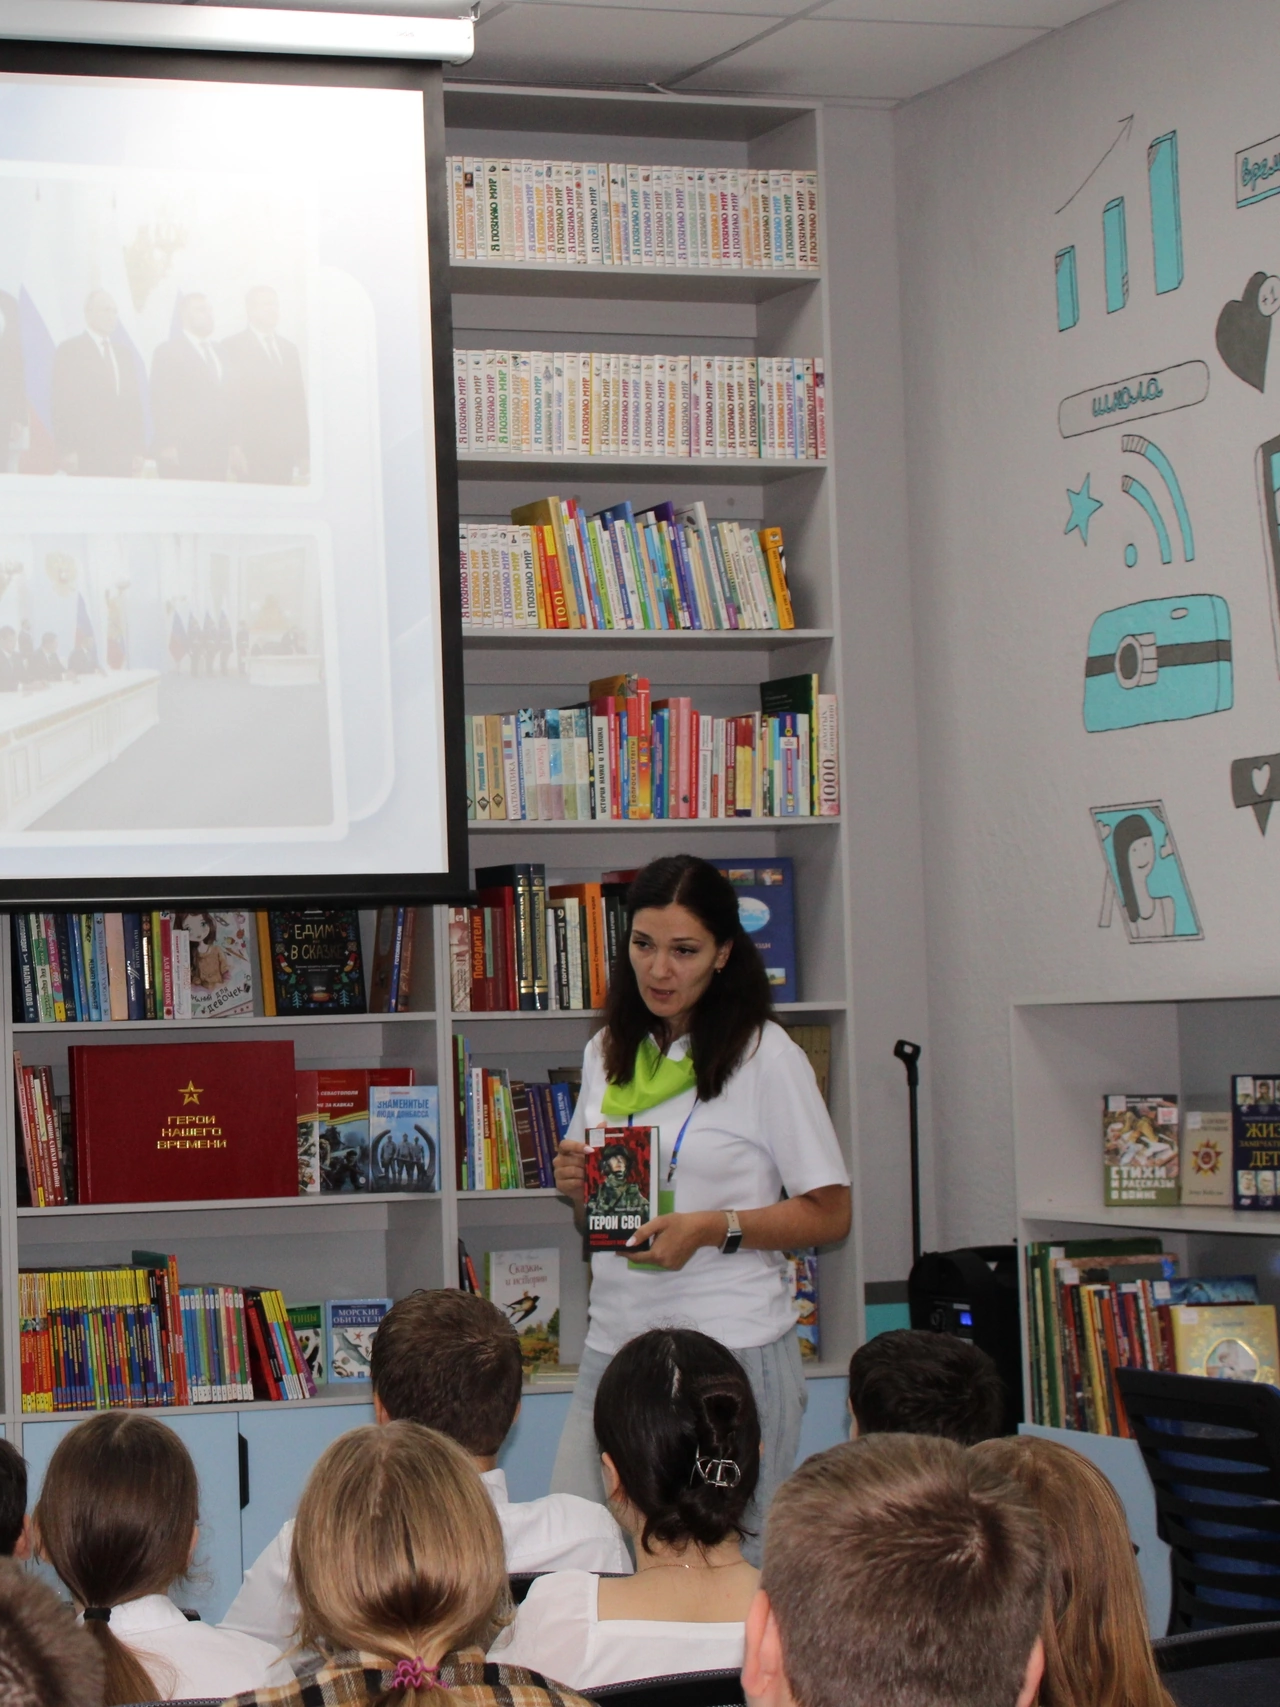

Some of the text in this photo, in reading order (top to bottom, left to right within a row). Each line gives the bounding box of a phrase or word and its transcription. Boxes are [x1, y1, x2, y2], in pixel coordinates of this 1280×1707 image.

[589, 186, 597, 206] МИР
[488, 178, 500, 252] Я ПОЗНАЮ МИР
[590, 207, 599, 245] ПОЗНАЮ
[458, 376, 466, 396] МИР
[498, 370, 508, 444] Я ПОЗНАЮ МИР
[1092, 377, 1163, 417] школа
[458, 397, 467, 435] ПОЗНАЮ
[524, 550, 536, 618] Я ПОЗНАЮ МИР
[554, 590, 568, 622] 1001
[598, 727, 606, 754] ТЕХНИКИ
[508, 761, 519, 816] МАТЕМАТИКА
[822, 759, 836, 803] 1000
[294, 924, 336, 940] ЕДИМ
[291, 944, 344, 960] В СКАЗКЕ
[473, 916, 484, 979] Победители
[591, 913, 601, 996] Экономика Ставропольского
[23, 965, 34, 1006] МАЛЬЧИКОВ
[376, 1110, 429, 1118] ЛЮДИ ДОНБАССА
[377, 1099, 429, 1109] ЗНАМЕНИТЫЕ
[46, 1114, 54, 1140] ЛУЧШИЕ
[168, 1115, 215, 1125] ГЕРОИ
[161, 1127, 222, 1137] НАШЕГО
[49, 1140, 57, 1162] СТИХИ
[157, 1139, 227, 1149] ВРЕМЕНИ
[1110, 1166, 1167, 1179] СТИХИ
[1111, 1179, 1175, 1188] И РАССКАЗЫ
[1111, 1190, 1156, 1200] О ВОЙНЕ
[589, 1215, 642, 1230] ГЕРОИ СВО
[508, 1262, 543, 1275] Сказки
[338, 1308, 380, 1316] МОРСКИЕ
